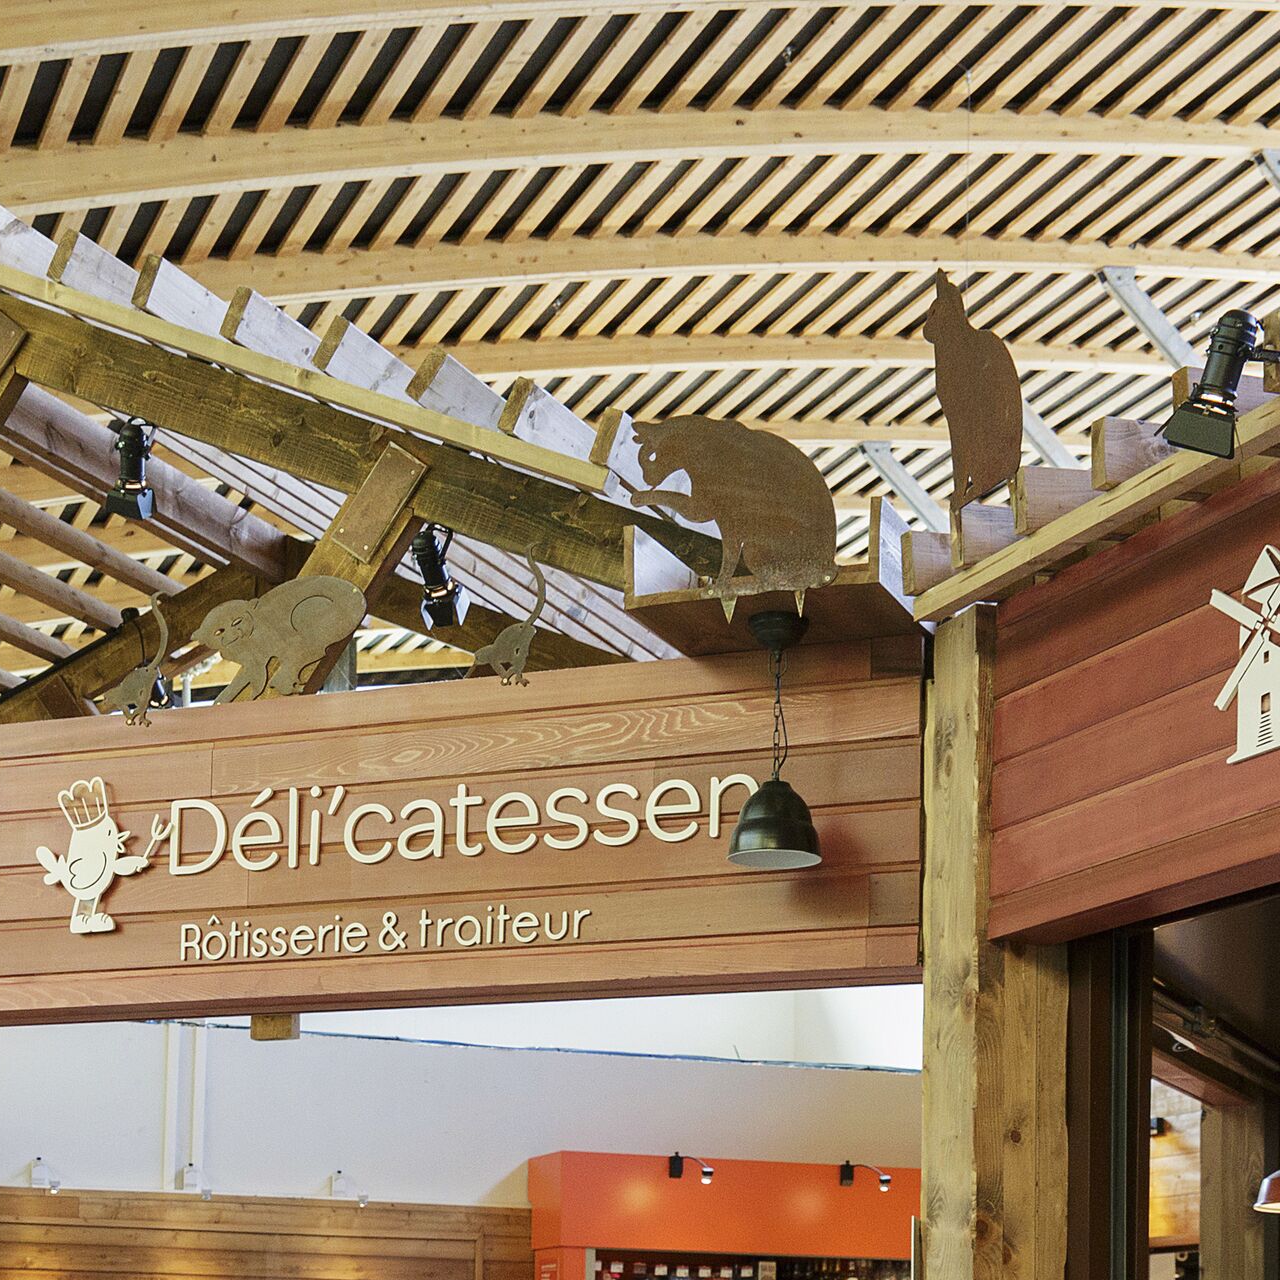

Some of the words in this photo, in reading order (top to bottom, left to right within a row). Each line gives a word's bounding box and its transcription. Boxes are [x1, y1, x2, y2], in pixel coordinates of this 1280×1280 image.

[168, 771, 762, 877] Déli'catessen
[180, 913, 369, 962] Rôtisserie
[378, 914, 408, 952] &
[418, 902, 592, 949] traiteur
